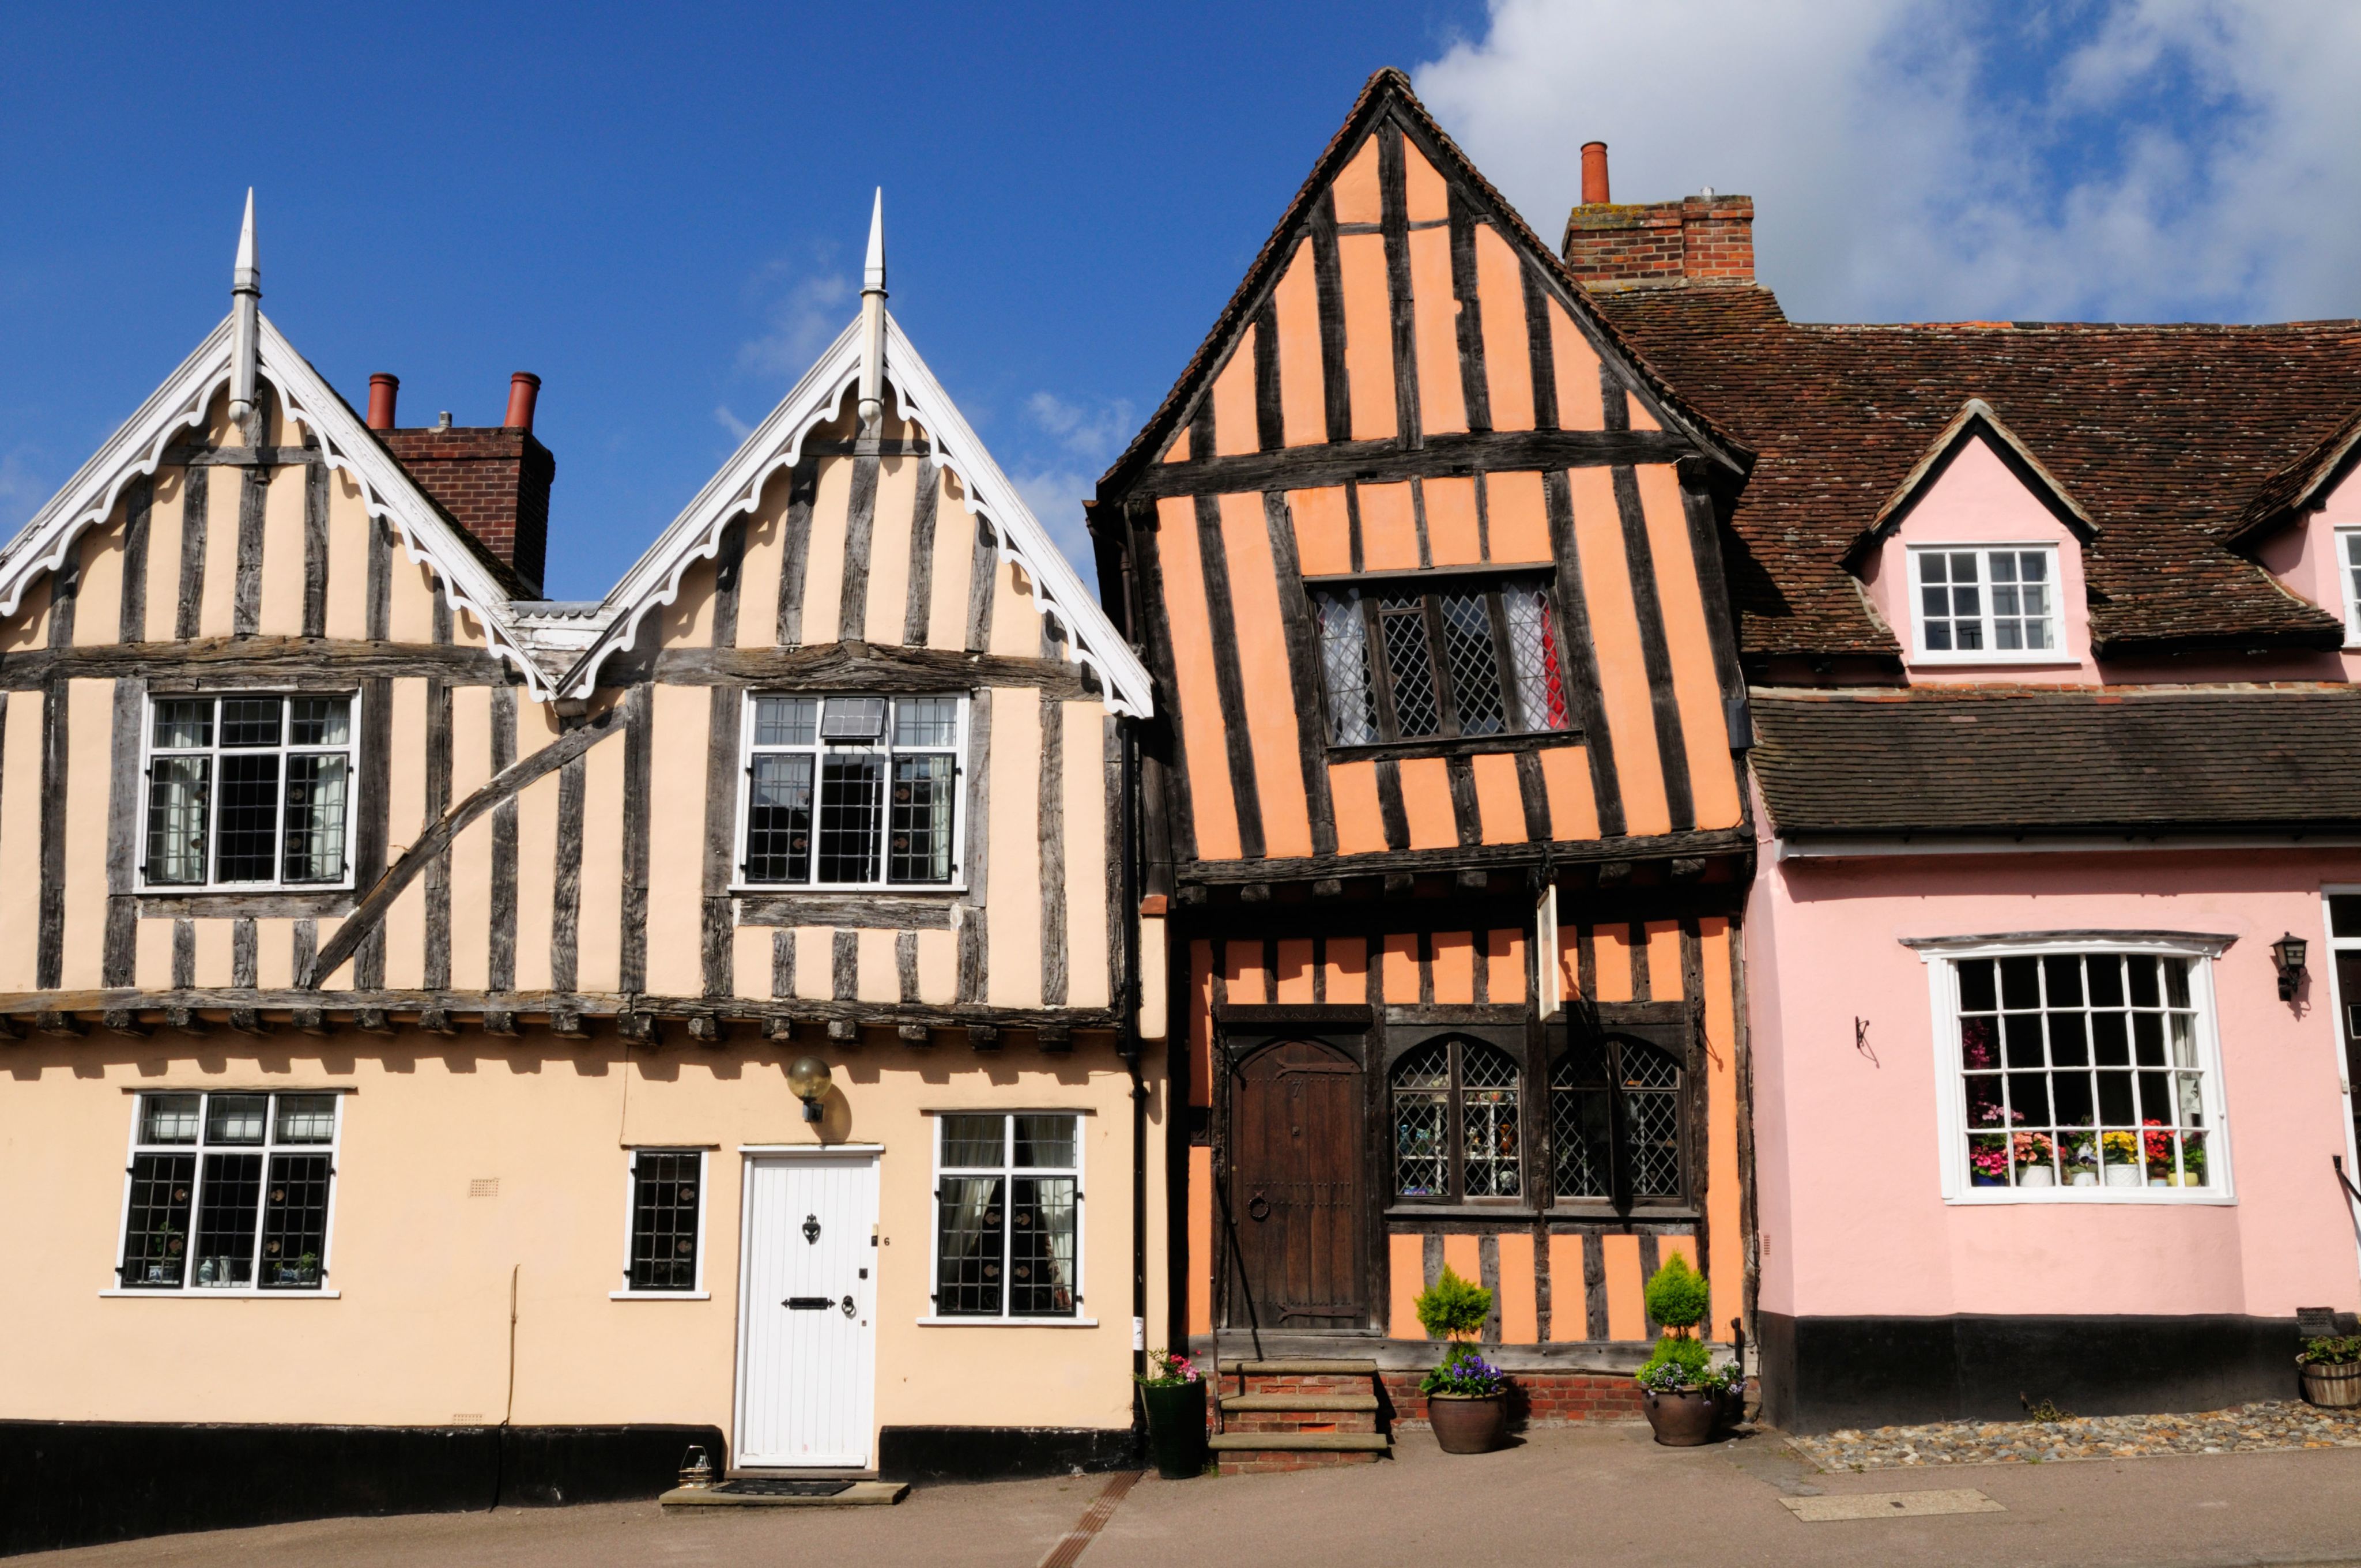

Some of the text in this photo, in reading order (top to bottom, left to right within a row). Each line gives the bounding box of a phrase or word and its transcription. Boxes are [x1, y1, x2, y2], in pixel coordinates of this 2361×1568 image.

[1227, 1007, 1366, 1019] THE CROOKED HOUSE
[1291, 1080, 1304, 1098] 7
[884, 1237, 890, 1246] 6
